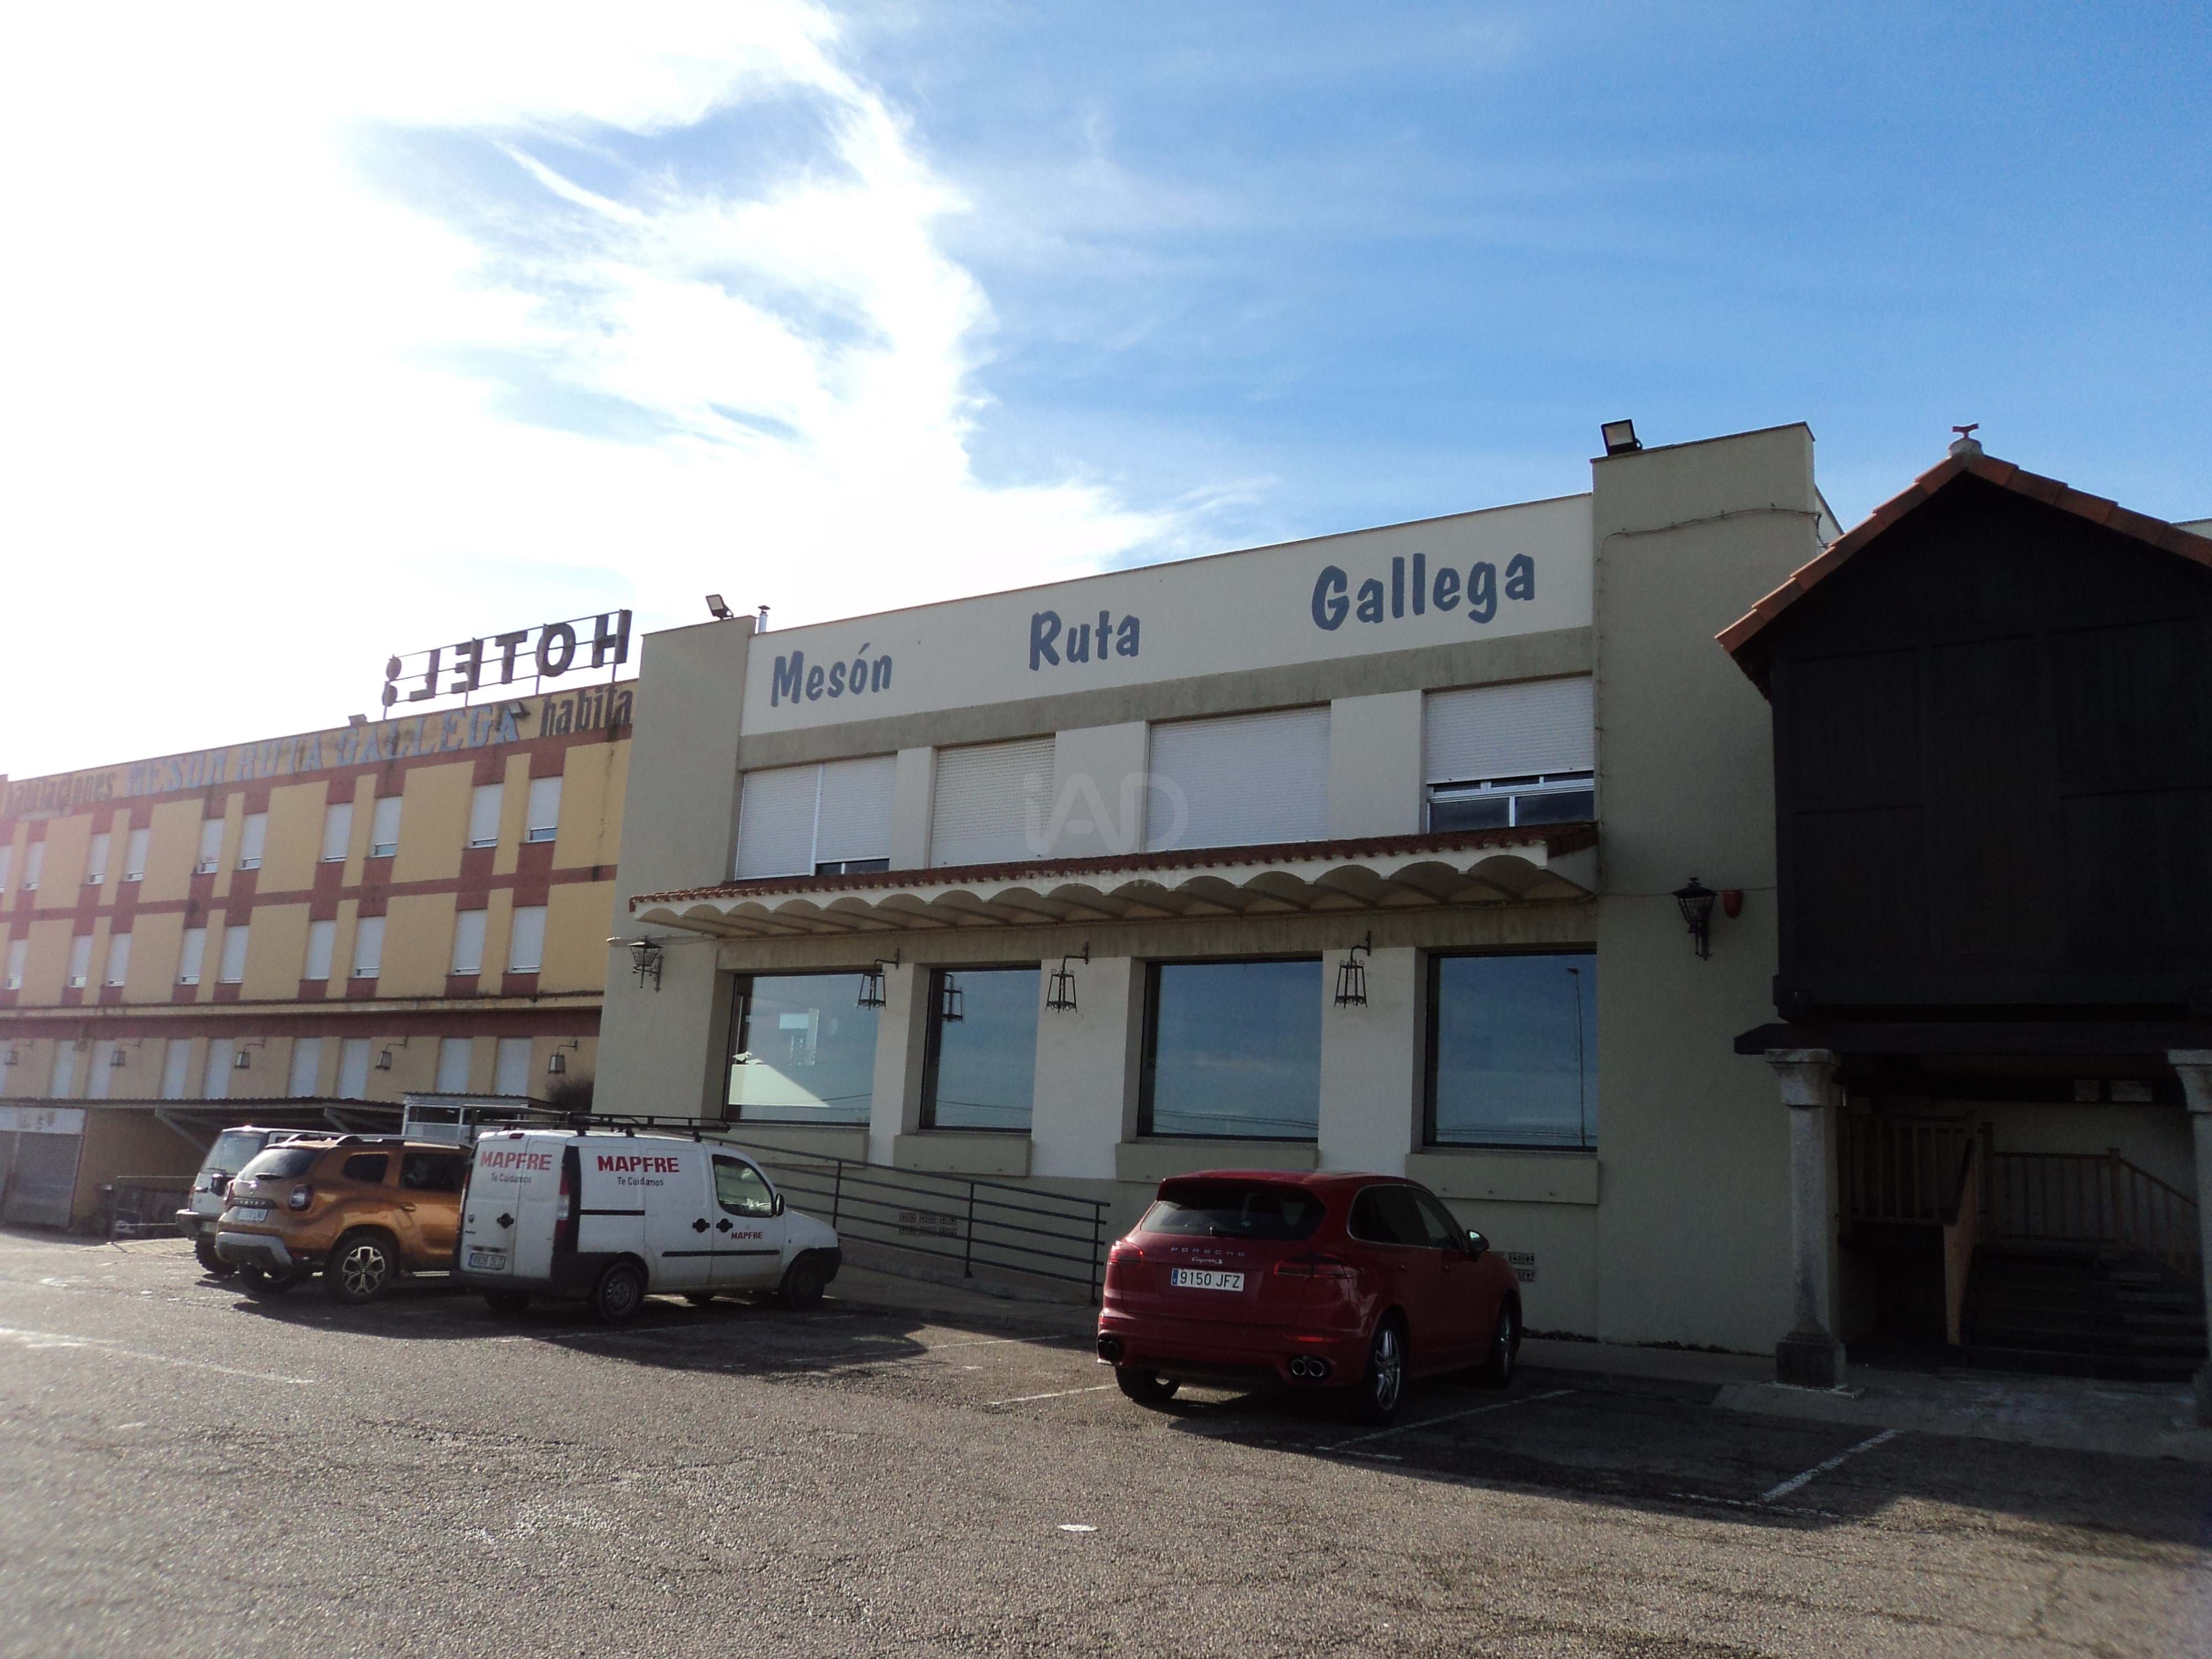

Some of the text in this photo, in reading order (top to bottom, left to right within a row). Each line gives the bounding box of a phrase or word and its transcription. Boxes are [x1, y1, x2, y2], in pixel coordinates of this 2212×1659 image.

[771, 553, 1535, 708] Mesón Ruta Gallega
[540, 685, 633, 737] habita
[236, 734, 323, 782] RUTA
[336, 705, 520, 766] GALLEGA
[480, 1151, 552, 1171] MAPFRE
[597, 1156, 680, 1173] MAPFRE
[491, 1173, 497, 1182] Te
[617, 1177, 664, 1186] Te Cuidamos
[1171, 1247, 1245, 1256] PORSCHE
[1180, 1271, 1240, 1288] 9150 JFZ
